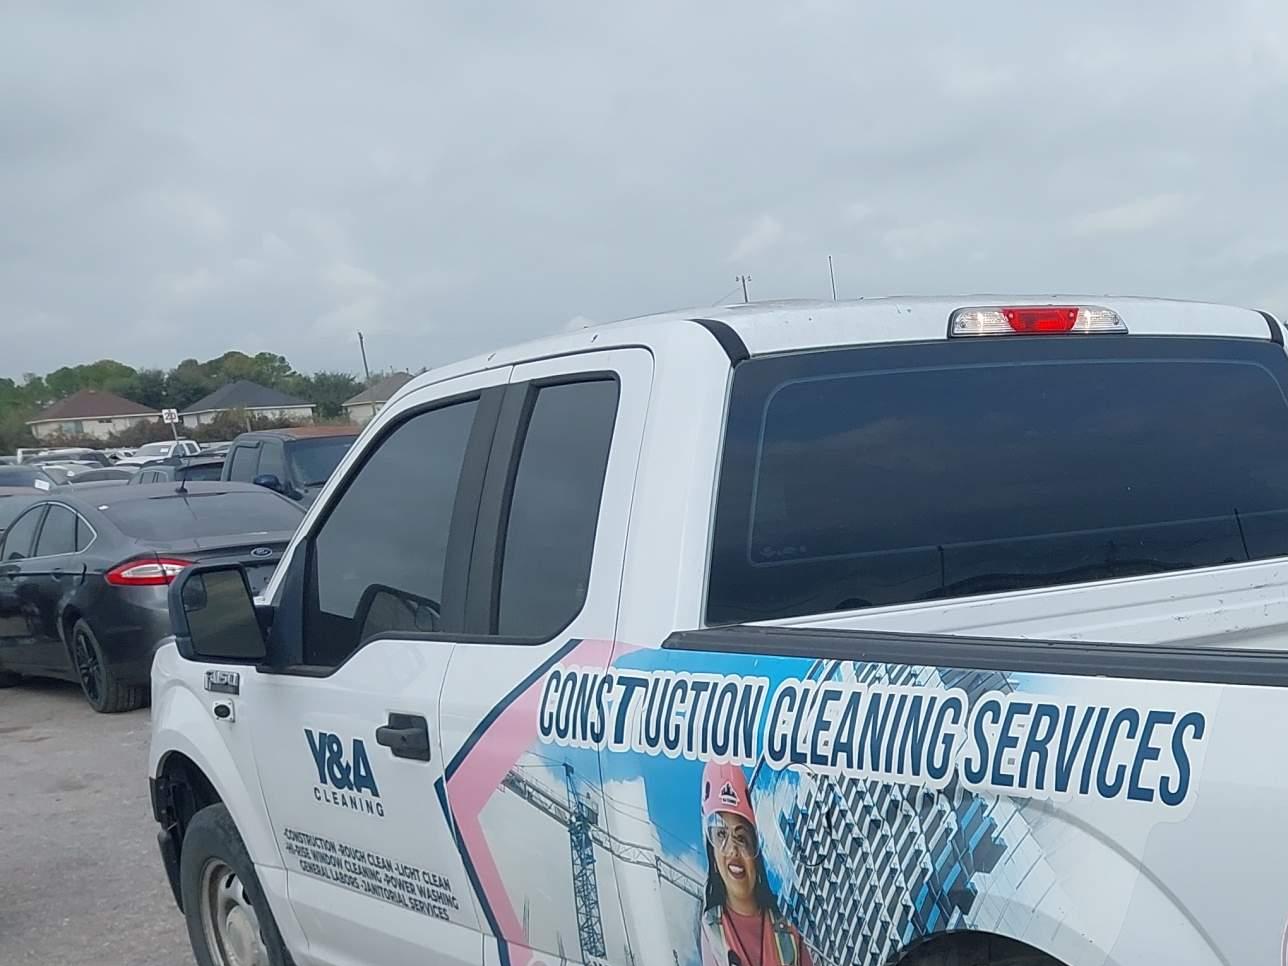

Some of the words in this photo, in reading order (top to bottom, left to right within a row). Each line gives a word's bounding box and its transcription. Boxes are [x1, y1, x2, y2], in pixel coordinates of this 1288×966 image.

[304, 728, 380, 798] Y&A
[539, 670, 764, 758] CONSTUCTION
[768, 685, 963, 780] CLEANING
[964, 700, 1206, 806] SERVICES
[314, 787, 384, 817] CLEANING
[300, 860, 332, 880] GENERAL
[408, 898, 449, 920] SERVICES
[312, 850, 343, 870] WINDOW
[344, 861, 382, 884] CLEANING
[416, 884, 459, 910] WASHING
[367, 853, 394, 873] CLEAN
[422, 871, 452, 892] CLEAN
